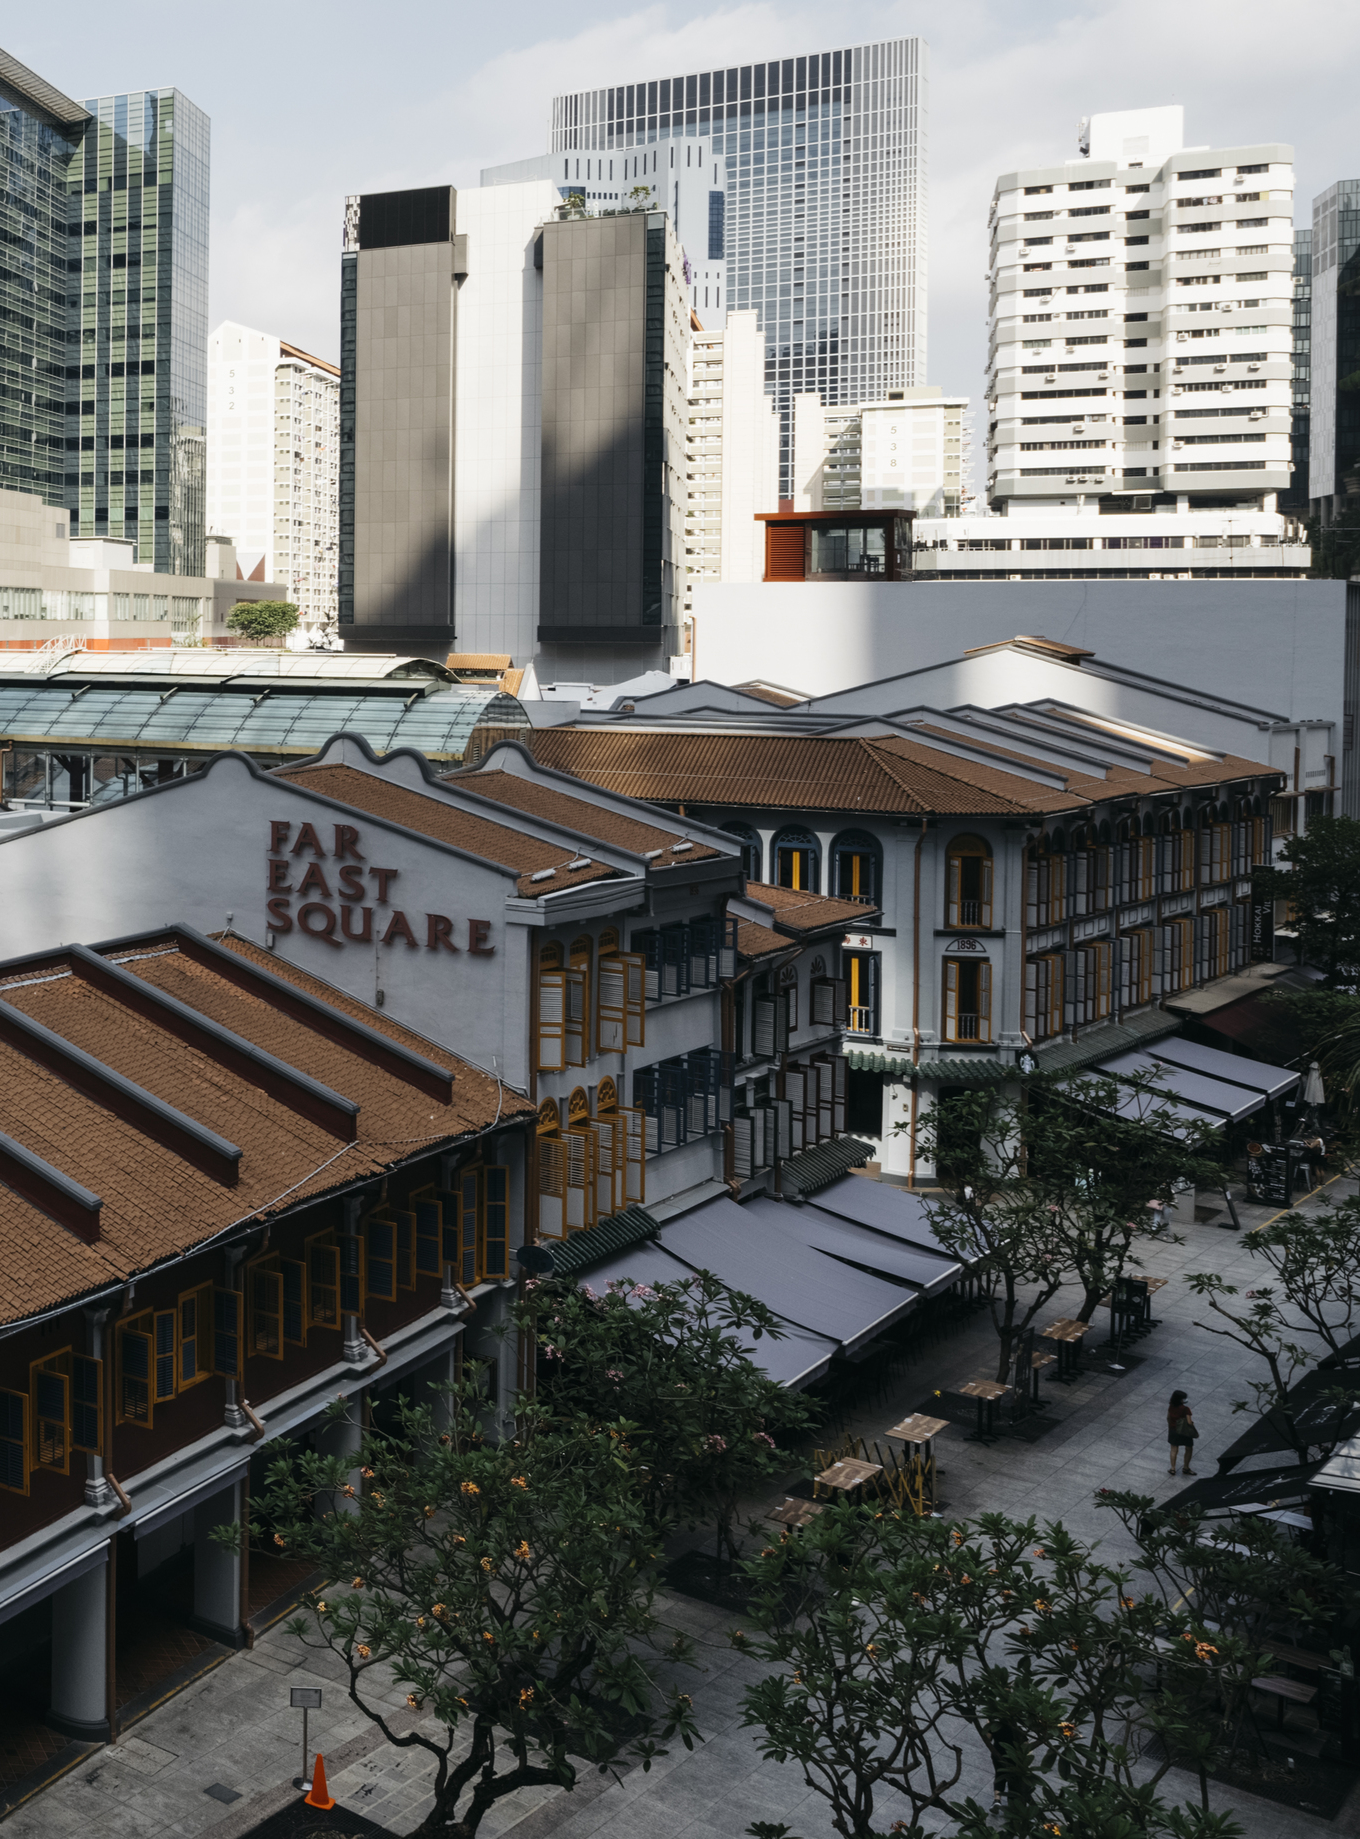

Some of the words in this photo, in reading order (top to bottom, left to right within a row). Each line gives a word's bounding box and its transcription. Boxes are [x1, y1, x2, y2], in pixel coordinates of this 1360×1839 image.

[268, 820, 366, 860] FAR
[267, 859, 398, 902] EAST
[267, 898, 496, 955] SQUARE
[1252, 905, 1262, 943] HOKKAI
[957, 939, 977, 950] 1896
